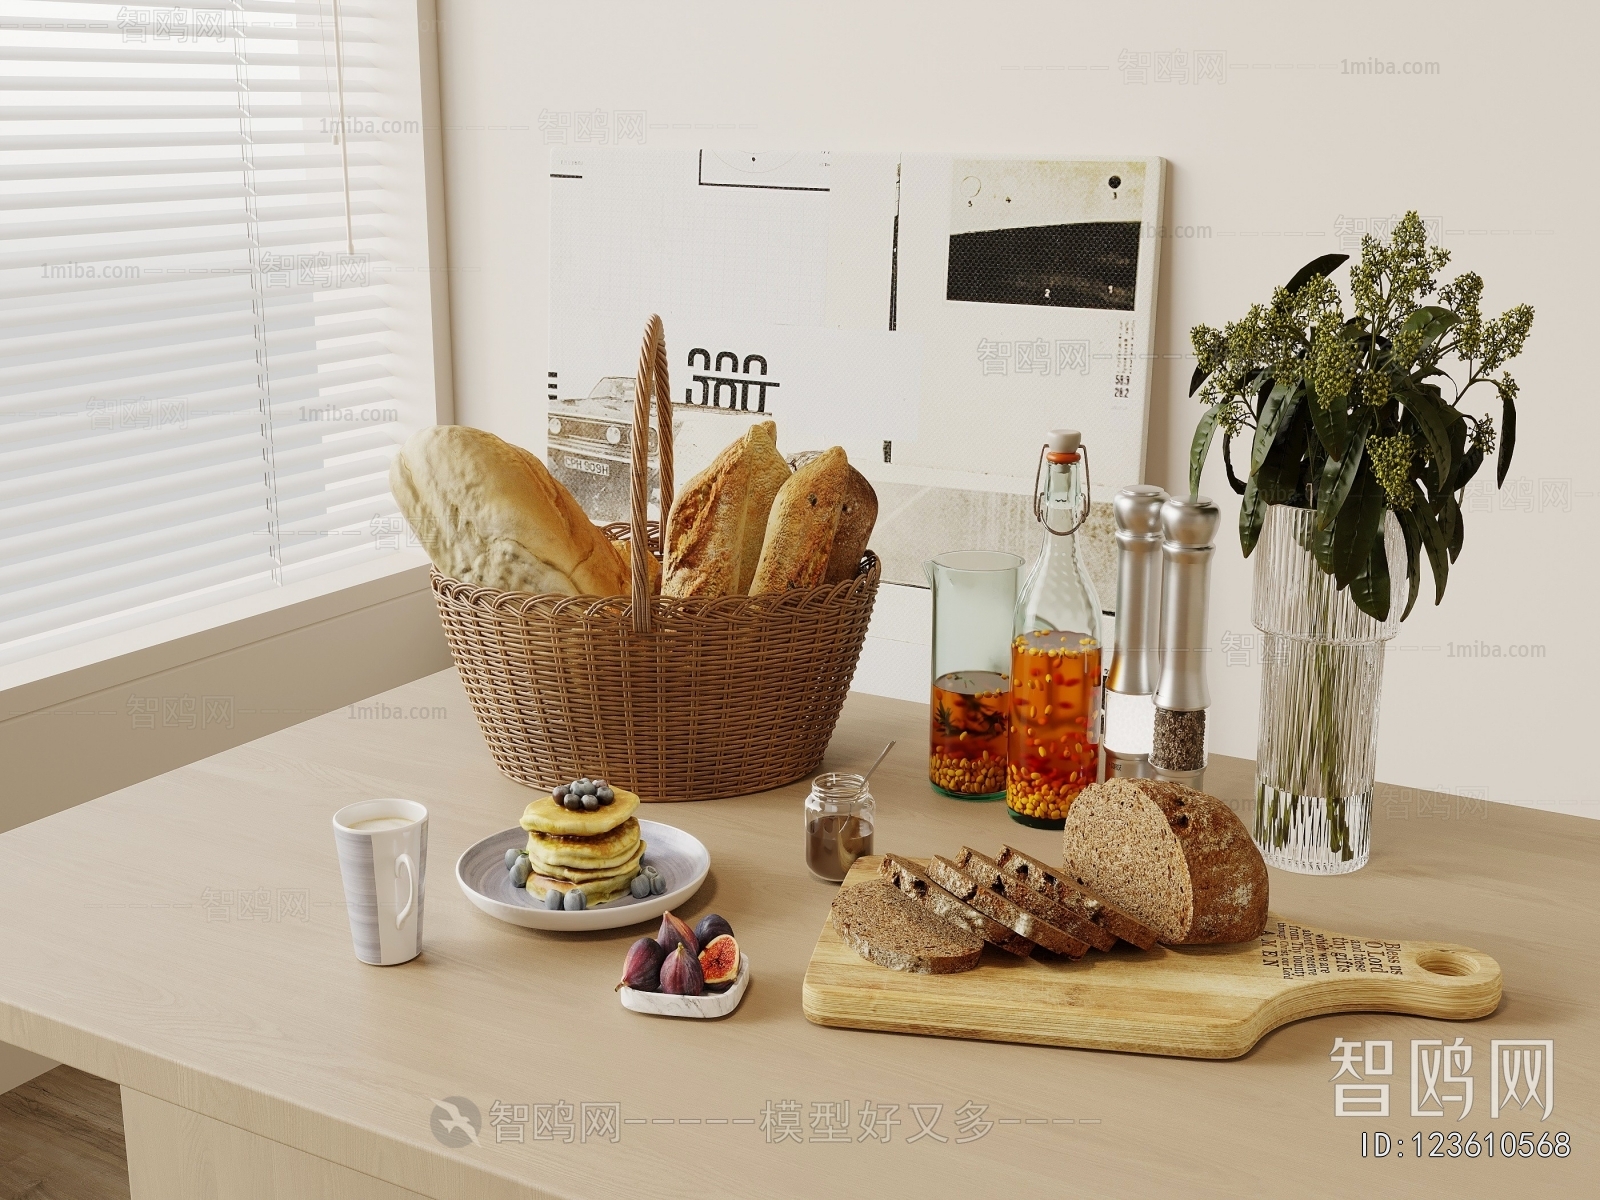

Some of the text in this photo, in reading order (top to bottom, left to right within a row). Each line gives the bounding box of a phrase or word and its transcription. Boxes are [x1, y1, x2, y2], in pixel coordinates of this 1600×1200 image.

[1277, 922, 1287, 941] through
[1281, 957, 1289, 967] our
[1288, 925, 1305, 978] from Thy bounty
[1302, 929, 1317, 976] about to receive
[1315, 934, 1330, 974] which we are
[1329, 937, 1353, 973] thy gifts
[1350, 939, 1367, 973] and these
[1365, 941, 1389, 974] O Lord
[1383, 941, 1403, 975] Bless us
[1283, 967, 1293, 980] Lord
